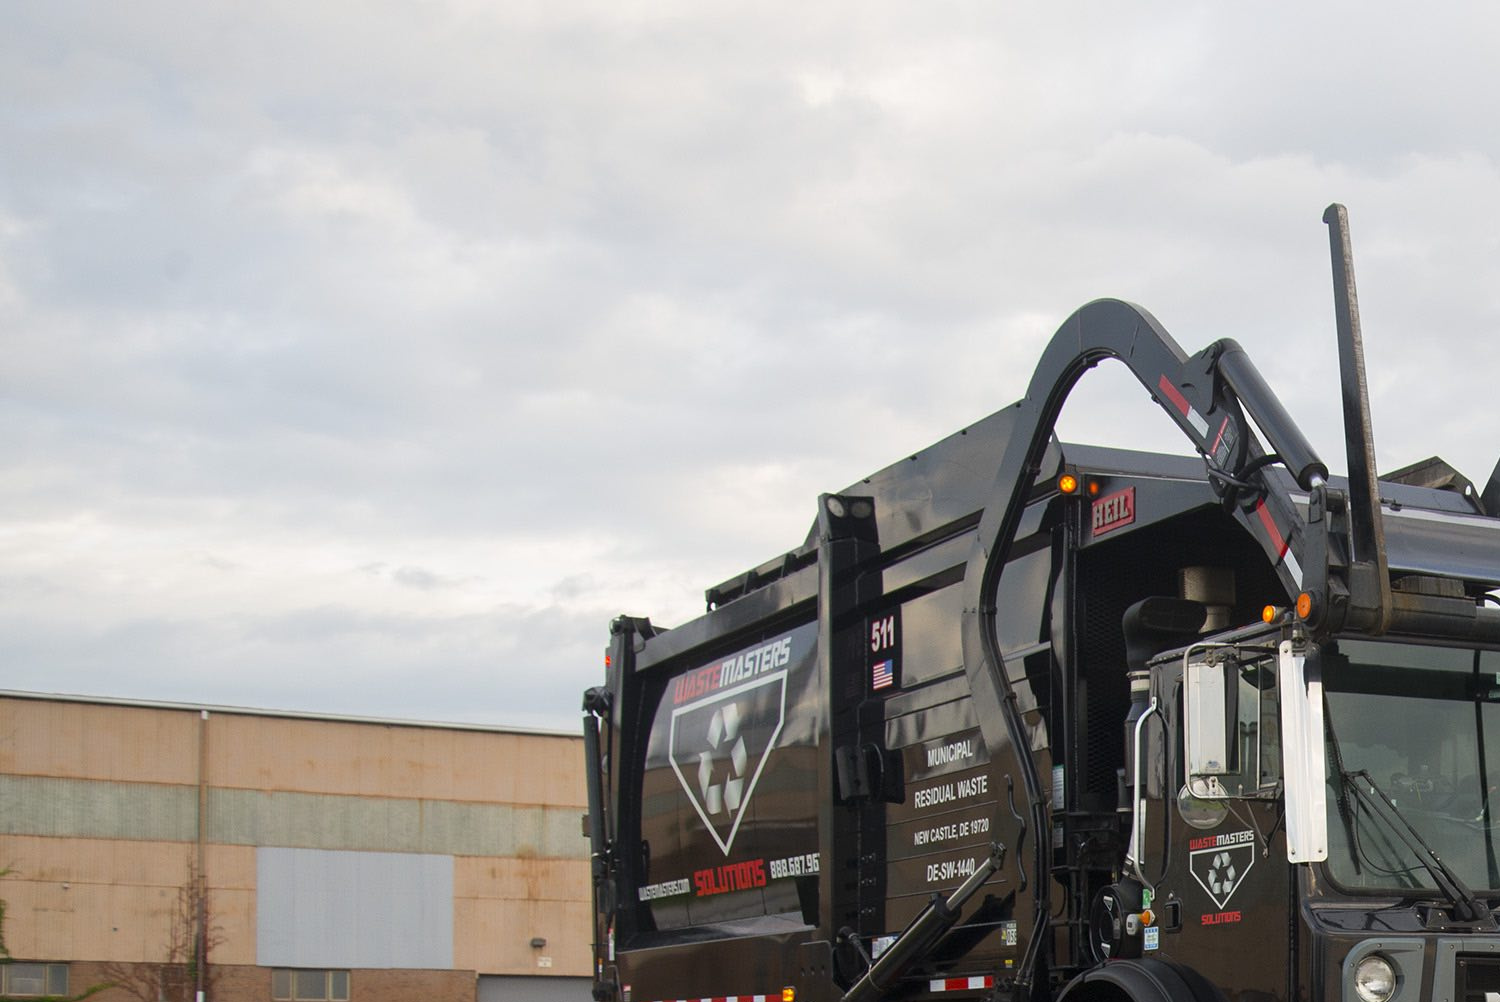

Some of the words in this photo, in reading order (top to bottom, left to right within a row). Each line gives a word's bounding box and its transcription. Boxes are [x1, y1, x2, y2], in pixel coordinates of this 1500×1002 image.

[1092, 495, 1129, 529] HEIL
[871, 615, 895, 652] 511
[927, 740, 973, 768] MUNICIPAL
[914, 783, 956, 809] RESIDUAL
[957, 775, 988, 799] WASTE
[914, 830, 930, 846] NEW
[930, 824, 959, 842] CASTLE,
[959, 821, 970, 837] DE
[970, 817, 990, 835] 19720
[1189, 830, 1255, 850] WASTEMASTERS
[693, 858, 767, 897] SOLUTIONS
[769, 852, 820, 880] 888.687.96
[926, 858, 976, 882] DE-SW-1440
[1201, 911, 1242, 925] SOLUTIONS
